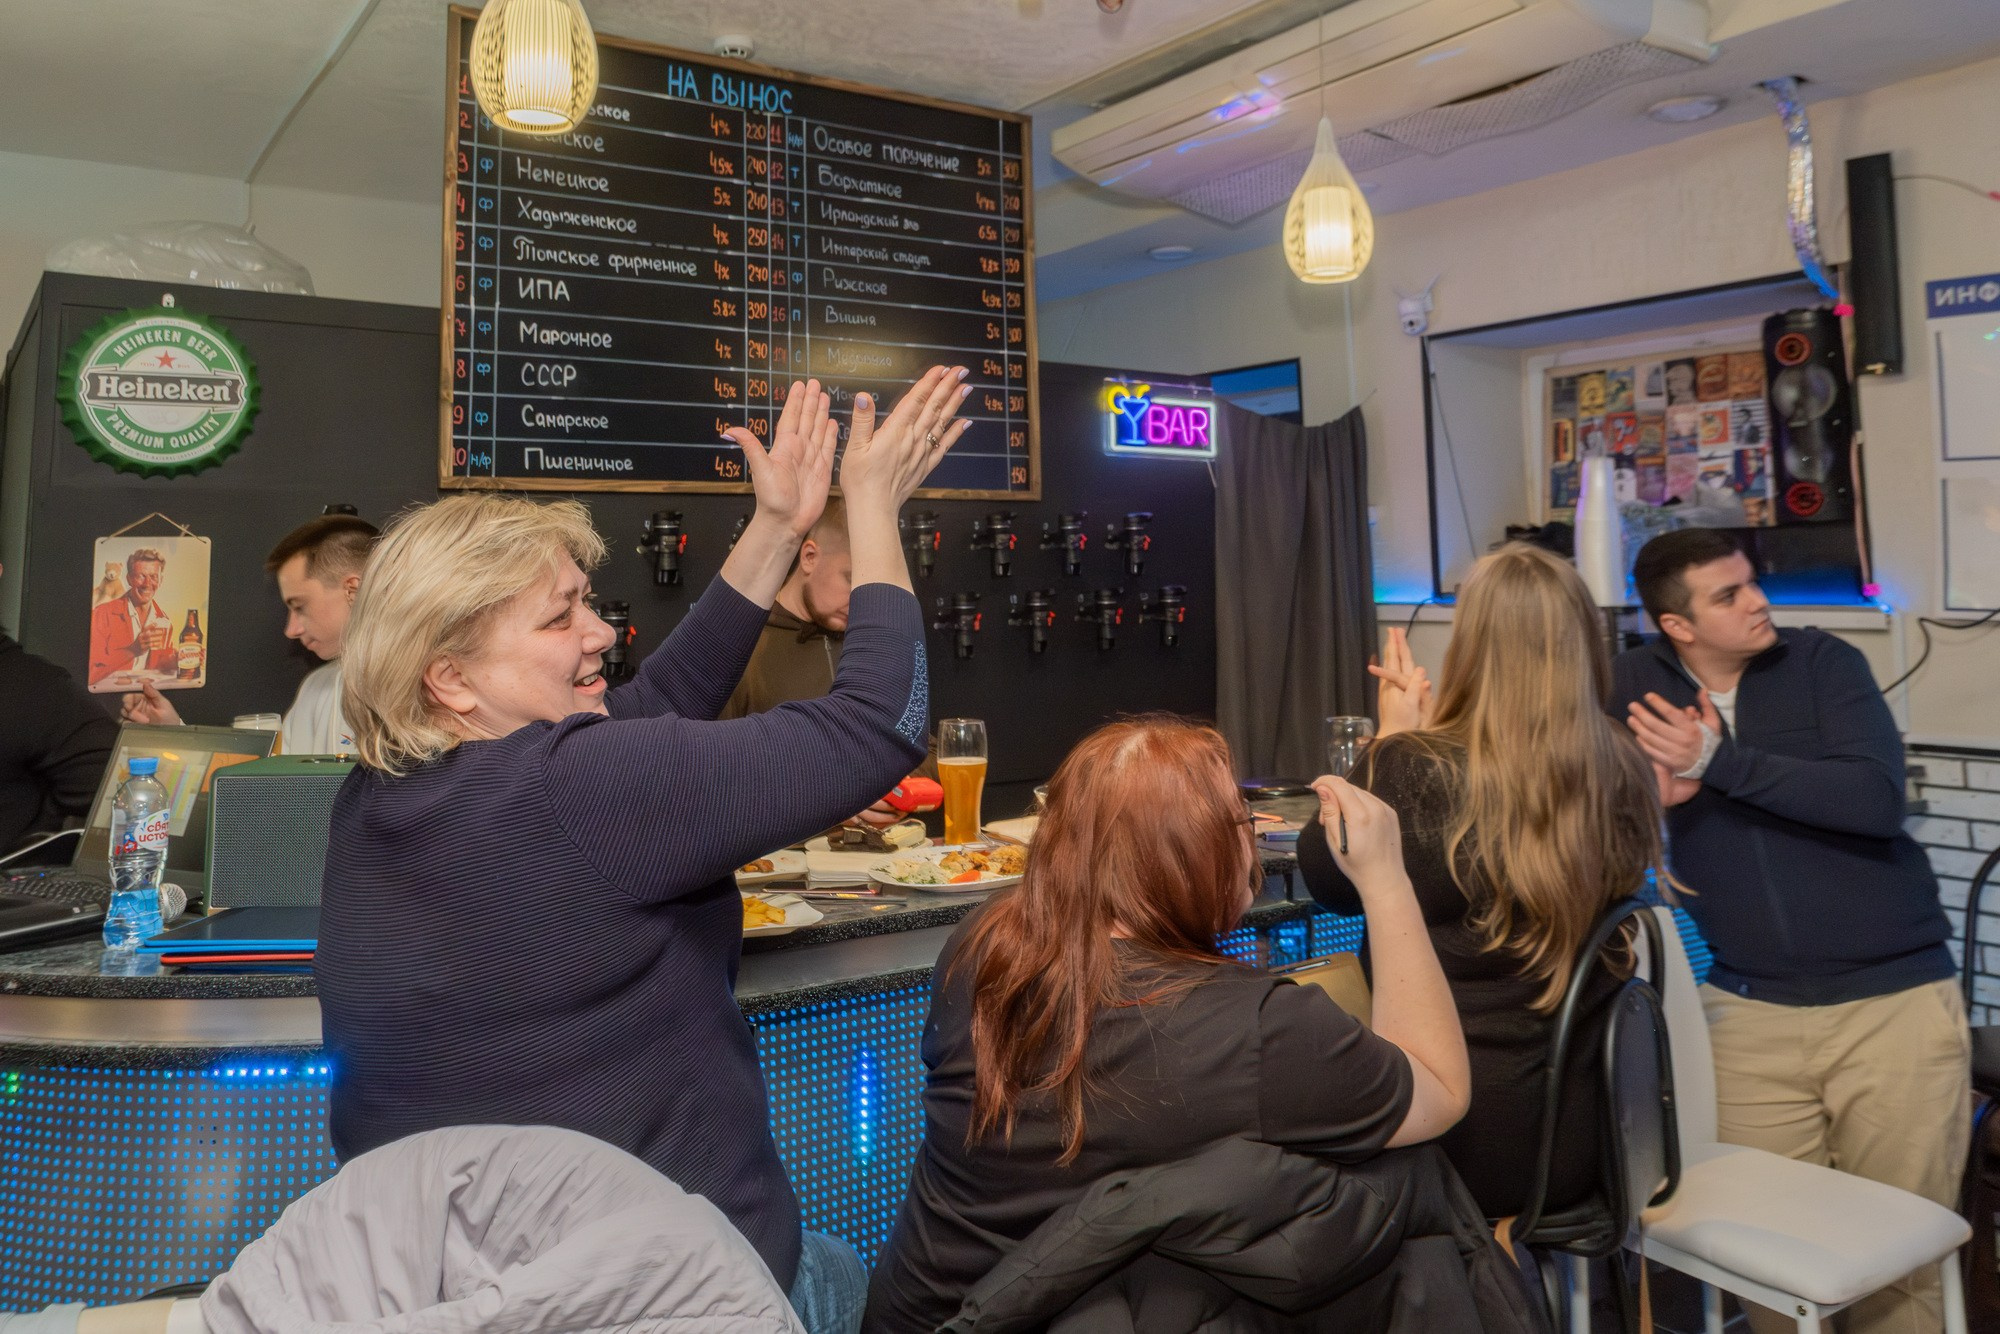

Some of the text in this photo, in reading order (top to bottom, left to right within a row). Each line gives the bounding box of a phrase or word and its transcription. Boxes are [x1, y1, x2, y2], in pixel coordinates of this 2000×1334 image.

[459, 73, 767, 140] 1 4% 220
[668, 64, 793, 114] НА ВЫНОС
[460, 111, 472, 128] 2
[747, 155, 767, 175] 240
[770, 123, 782, 144] 11
[882, 144, 960, 173] поручение
[457, 152, 768, 211] 3 ф Немецкое 5% 240
[770, 161, 785, 180] 12
[818, 163, 902, 199] Бархатное
[456, 191, 768, 247] 4 ф Хадыженское 4% 250
[771, 197, 785, 217] 13
[821, 201, 899, 229] Ирландский
[456, 232, 769, 283] 5 ф Томское фирменное 4% 270
[772, 232, 785, 252] 14
[893, 252, 931, 270] стаут
[456, 275, 466, 292] 6
[478, 276, 493, 291] ф
[518, 276, 570, 302] ИПА
[748, 301, 768, 320] 320
[772, 270, 786, 286] 15
[823, 267, 888, 296] Рижское
[772, 306, 787, 323] 16
[825, 305, 877, 327] Вишня
[113, 329, 218, 361] HEINEKEN BEER
[455, 318, 768, 360] 7 ф Марочное 4% 270
[97, 375, 231, 401] Heineken
[456, 358, 467, 379] 8
[476, 363, 491, 377] ф
[521, 362, 577, 388] СССР
[748, 378, 768, 398] 250
[773, 386, 786, 400] 18
[106, 413, 220, 449] PREMIUM QUALITY
[453, 405, 464, 425] 9
[474, 411, 489, 427] ф
[521, 403, 609, 433] Самарское
[748, 417, 768, 436] 260
[1147, 404, 1209, 447] BAR
[470, 451, 492, 470] н/ф
[524, 447, 634, 471] Пшеничное
[715, 456, 741, 478] 4.5%
